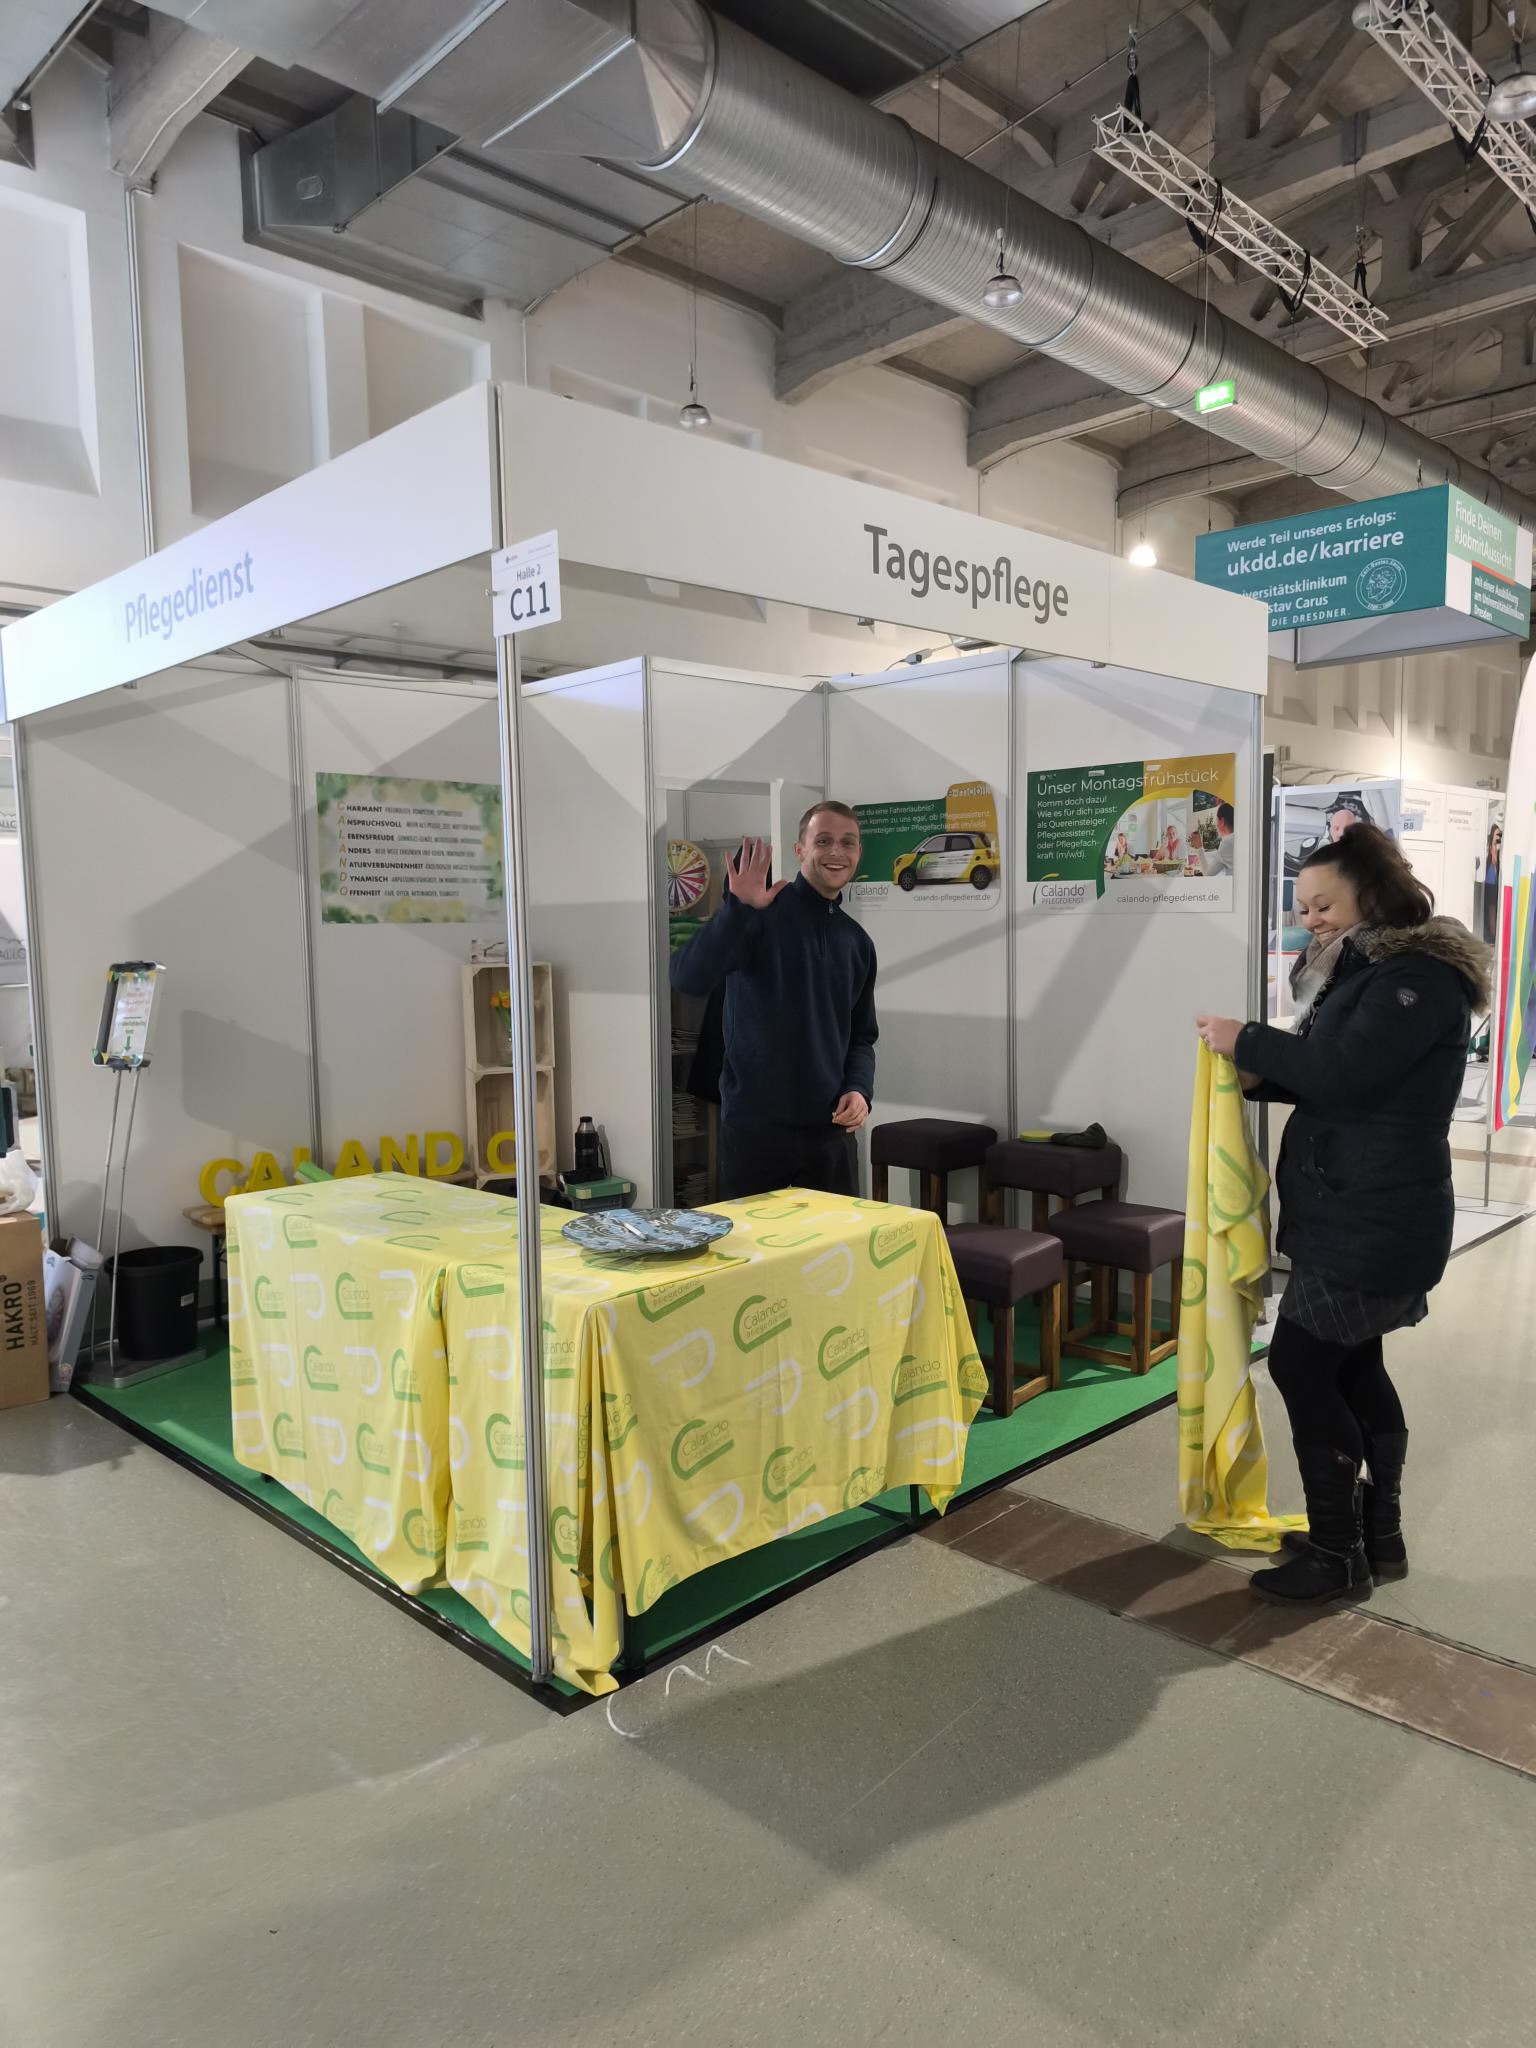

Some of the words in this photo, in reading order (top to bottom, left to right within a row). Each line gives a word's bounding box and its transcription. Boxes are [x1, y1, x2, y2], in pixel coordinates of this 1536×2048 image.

[1455, 500, 1476, 527] Finde
[1478, 513, 1502, 540] Deinen
[1227, 536, 1266, 553] Werde
[1269, 530, 1290, 545] Teil
[1293, 522, 1342, 540] unseres
[1346, 511, 1397, 530] Erfolgs:
[1227, 531, 1404, 576] ukdd.de/karriere
[516, 566, 536, 581] Halle
[536, 564, 542, 576] 2
[864, 523, 1069, 624] Tagespflege
[125, 551, 254, 643] Pflegedienst
[510, 581, 550, 621] C11
[1295, 596, 1328, 609] Carus
[1271, 618, 1288, 627] DIE
[1292, 607, 1351, 624] DRESDNER.
[1037, 782, 1077, 796] Unser
[1081, 769, 1219, 791] Montagsfrühstück
[890, 804, 935, 814] Fahrerlaubnis?
[1037, 800, 1063, 808] Komm
[1065, 798, 1084, 806] doch
[1086, 796, 1107, 804] dazu!
[1037, 810, 1052, 818] Wie
[1048, 818, 1107, 828] Quereinsteiger,
[1037, 829, 1095, 840] Pflegeassistenz
[1037, 841, 1054, 849] oder
[1037, 851, 1054, 860] kraft
[856, 884, 889, 896] Calando
[914, 893, 991, 902] calando-pflegedienst.de
[1041, 884, 1085, 897] Calando
[1117, 893, 1220, 905] calando-pflegedienst.de
[878, 1220, 914, 1247] Calando
[743, 1297, 788, 1330] Calando
[826, 1327, 866, 1359] Calando
[682, 1419, 730, 1456] Calando
